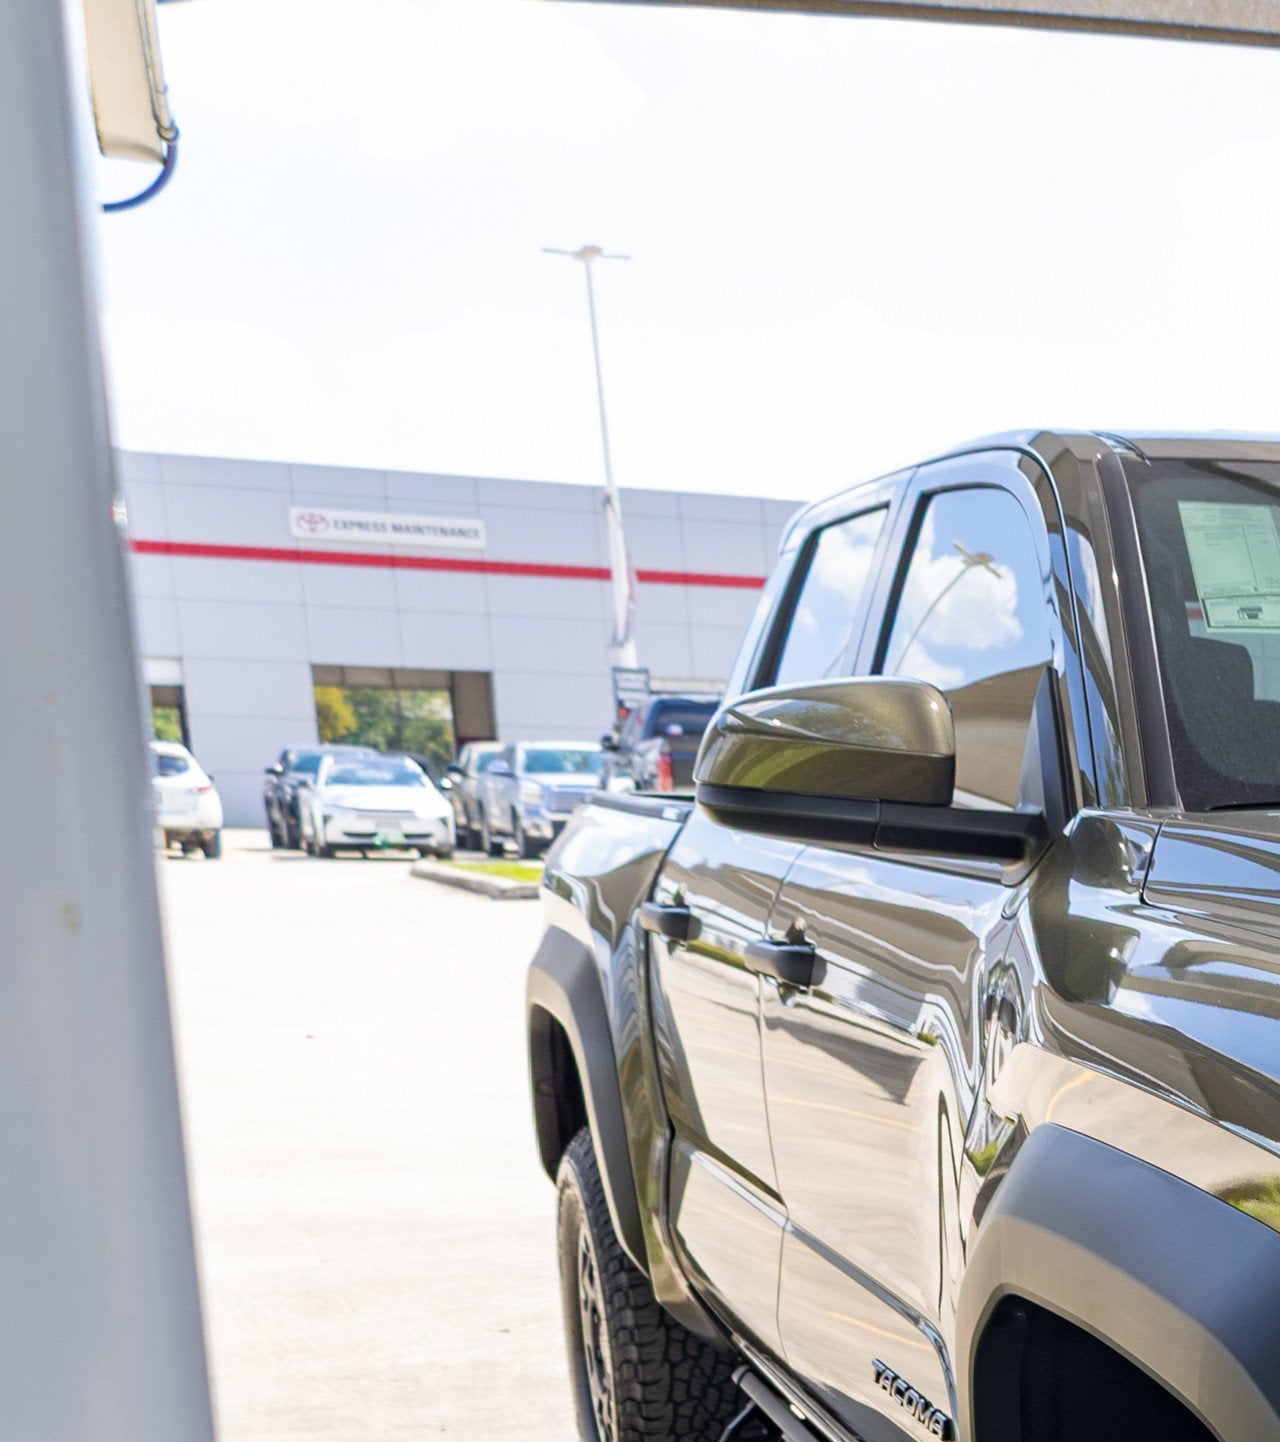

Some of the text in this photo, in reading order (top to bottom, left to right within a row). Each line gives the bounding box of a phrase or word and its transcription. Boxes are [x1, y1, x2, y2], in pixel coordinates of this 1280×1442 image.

[332, 518, 480, 539] EXPRESS MAINTENANCE
[871, 1358, 956, 1442] TACOMA
